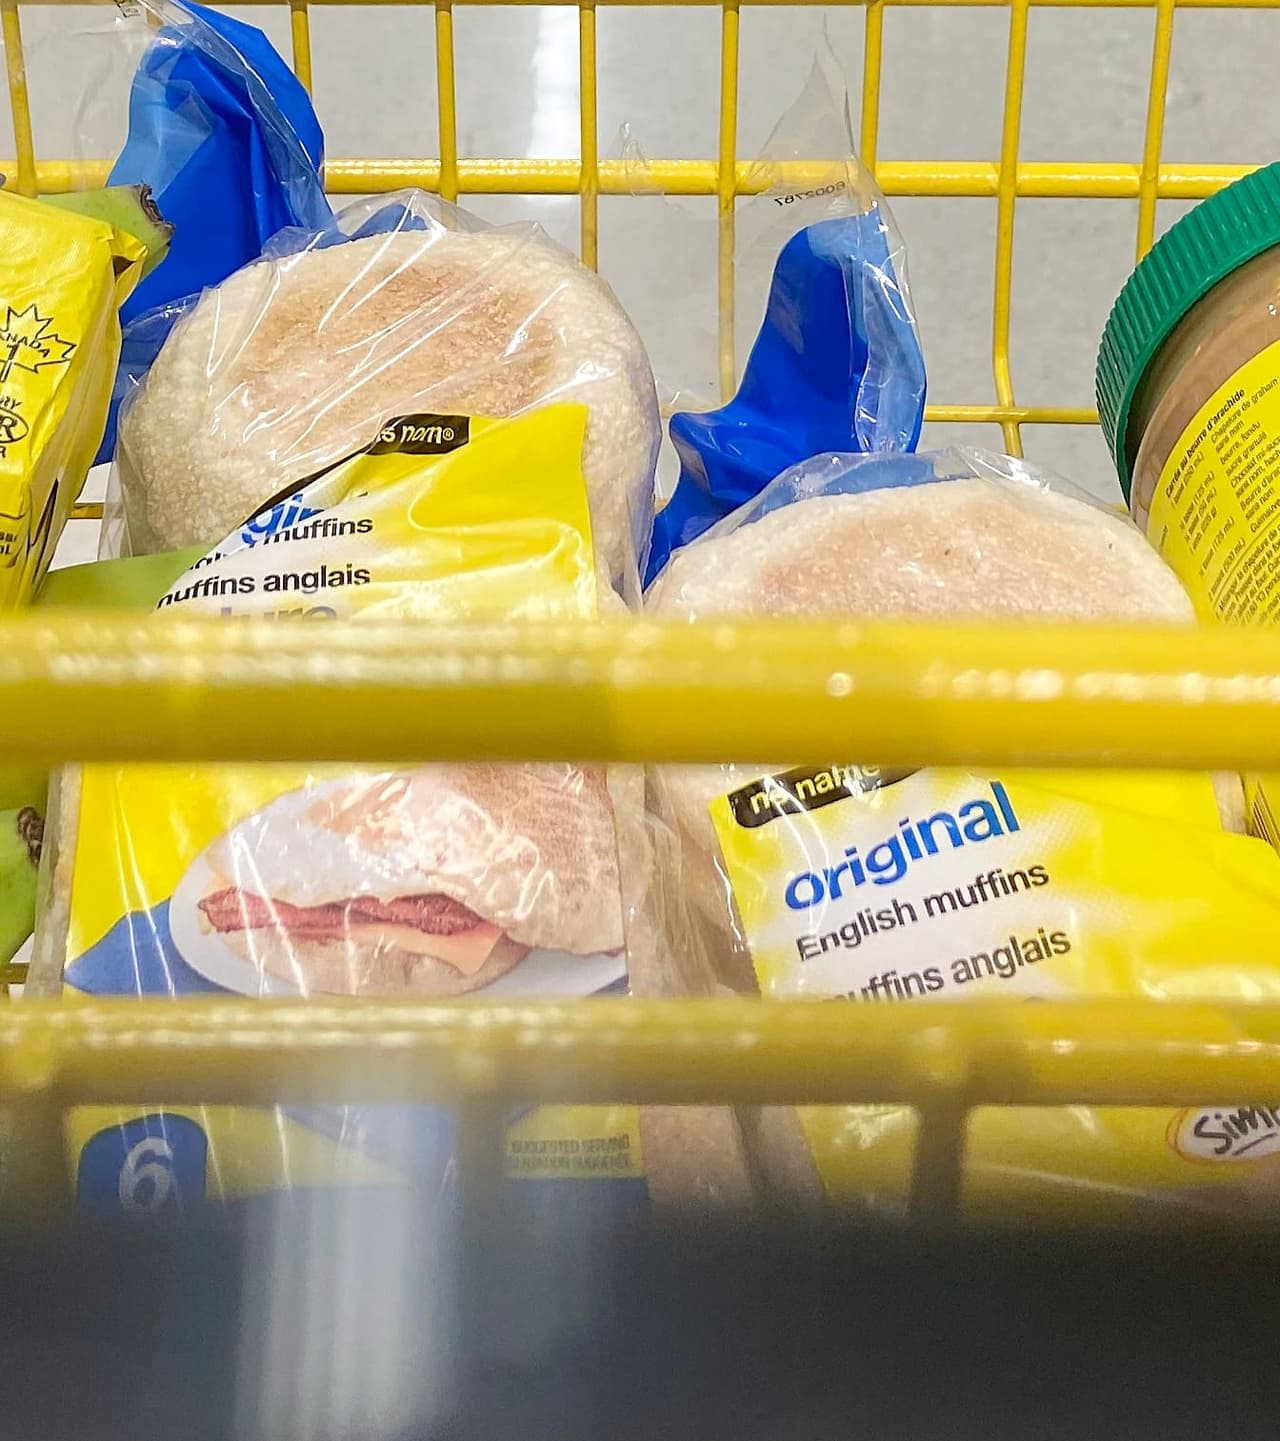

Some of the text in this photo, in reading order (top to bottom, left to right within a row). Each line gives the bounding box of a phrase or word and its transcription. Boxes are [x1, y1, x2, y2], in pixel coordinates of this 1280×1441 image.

[263, 563, 372, 595] anglais
[784, 780, 1020, 911] original
[796, 863, 1050, 962] English muffins
[949, 927, 1072, 985] anglais
[119, 1136, 175, 1216] 6
